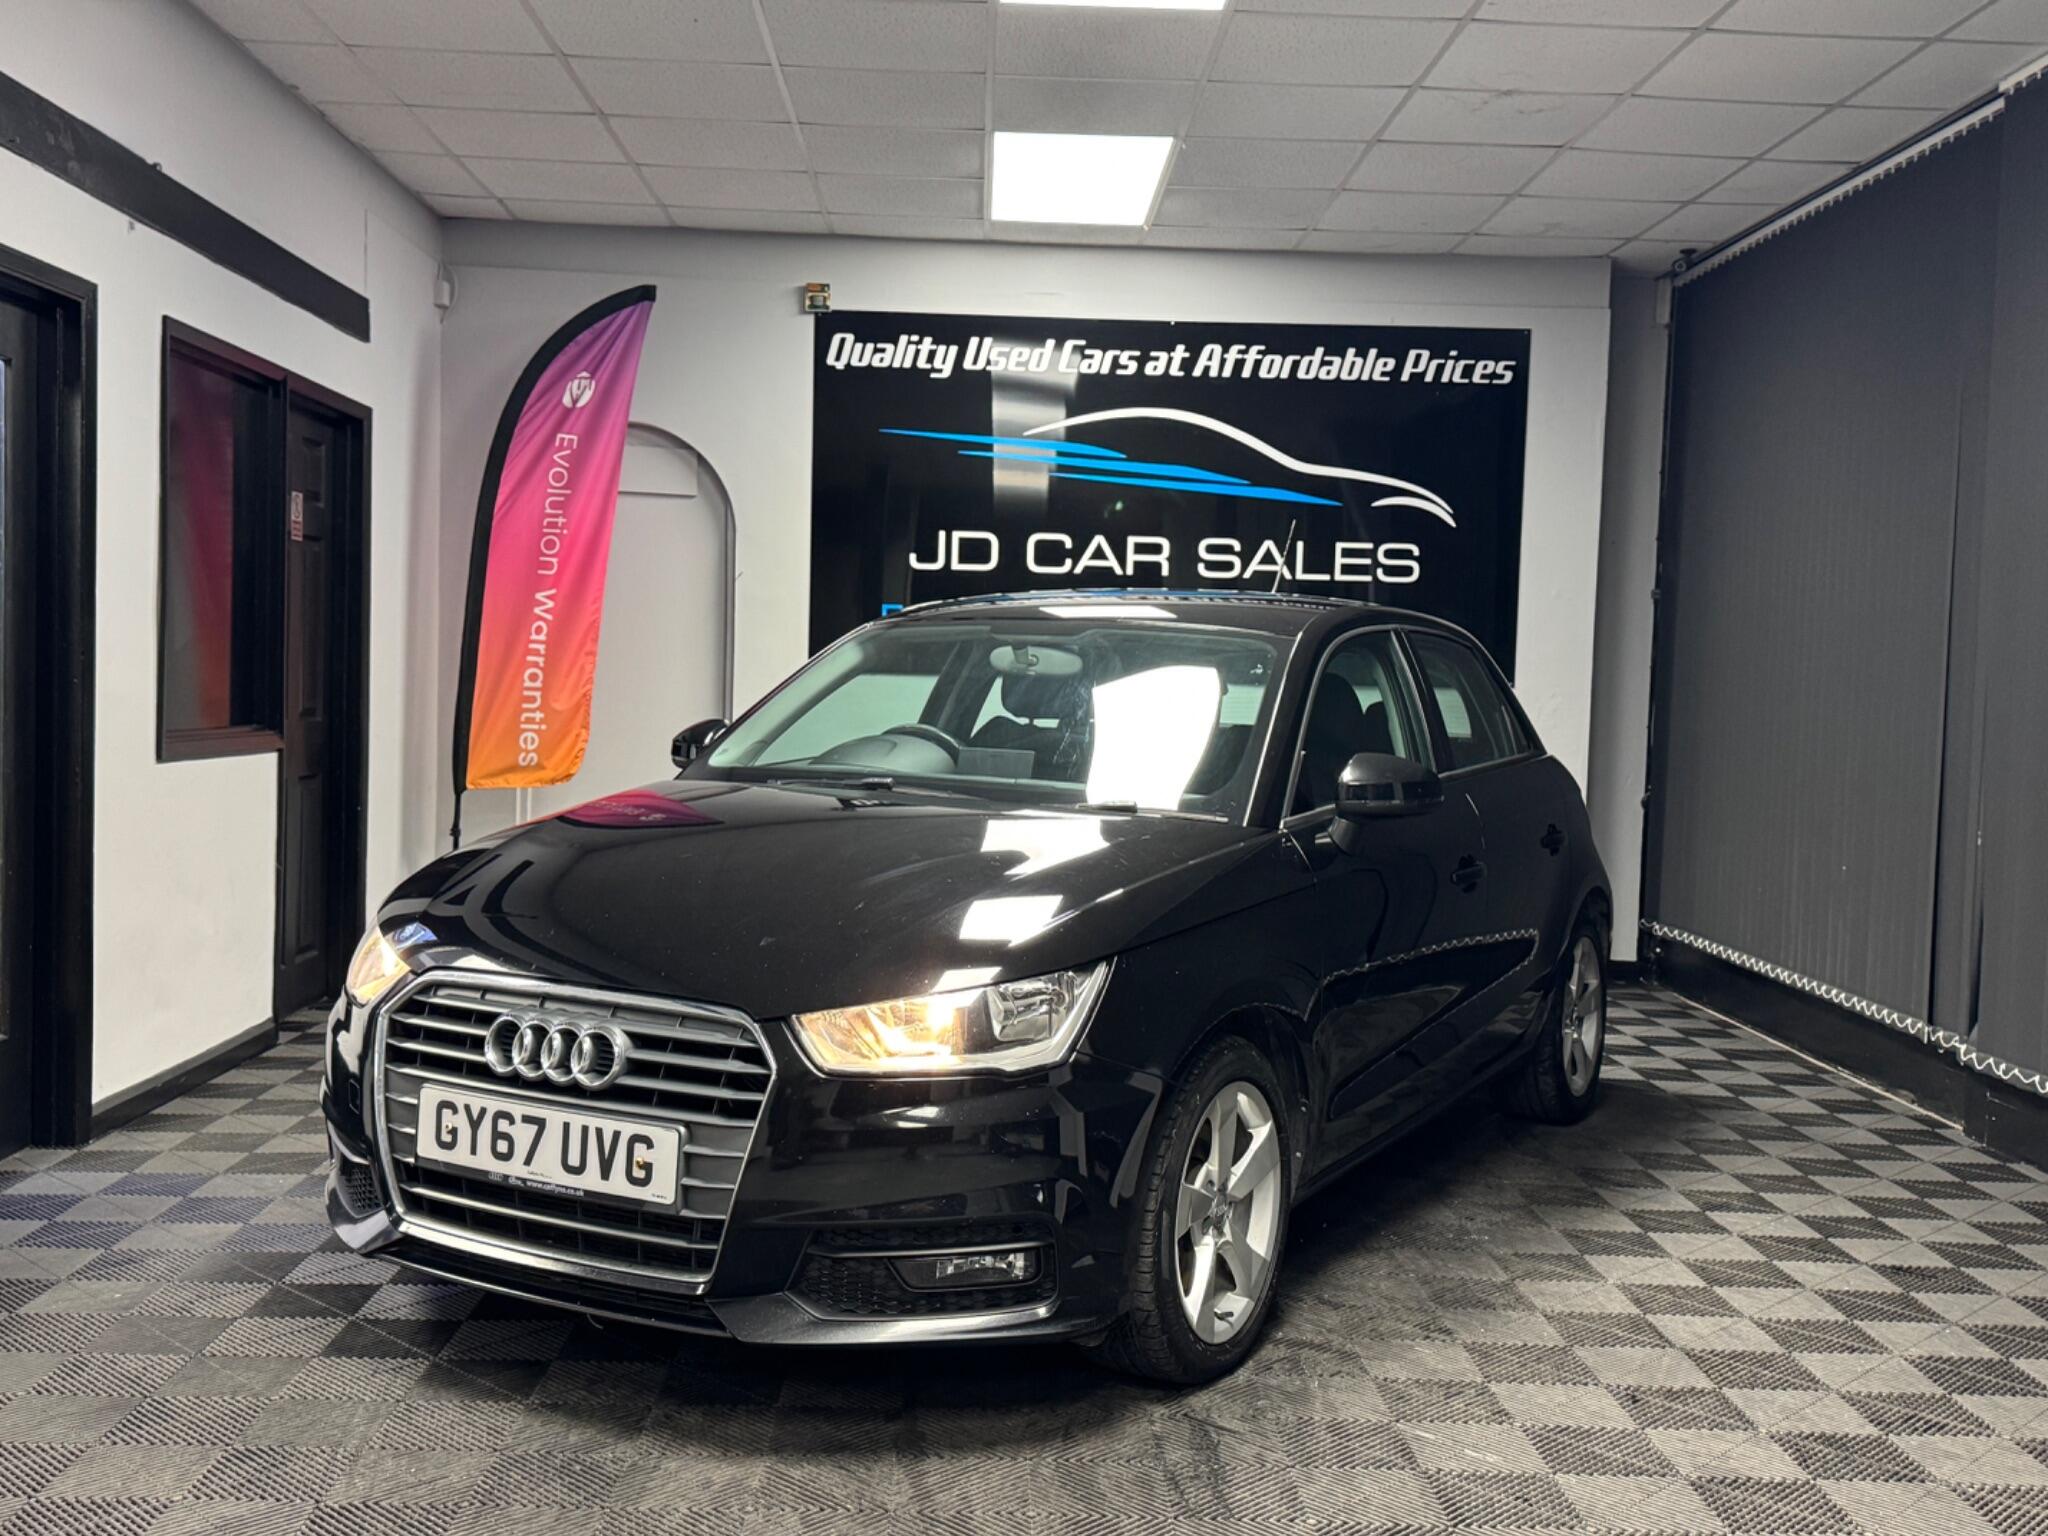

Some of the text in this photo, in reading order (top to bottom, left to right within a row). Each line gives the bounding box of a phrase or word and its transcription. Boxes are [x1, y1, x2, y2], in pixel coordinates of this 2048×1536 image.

[826, 333, 1516, 384] Quality Used Cars at Affordable Prices
[909, 530, 1420, 583] JD CAR SALES
[517, 432, 578, 767] Evolution Warranties
[436, 1100, 654, 1187] GY67 UVG
